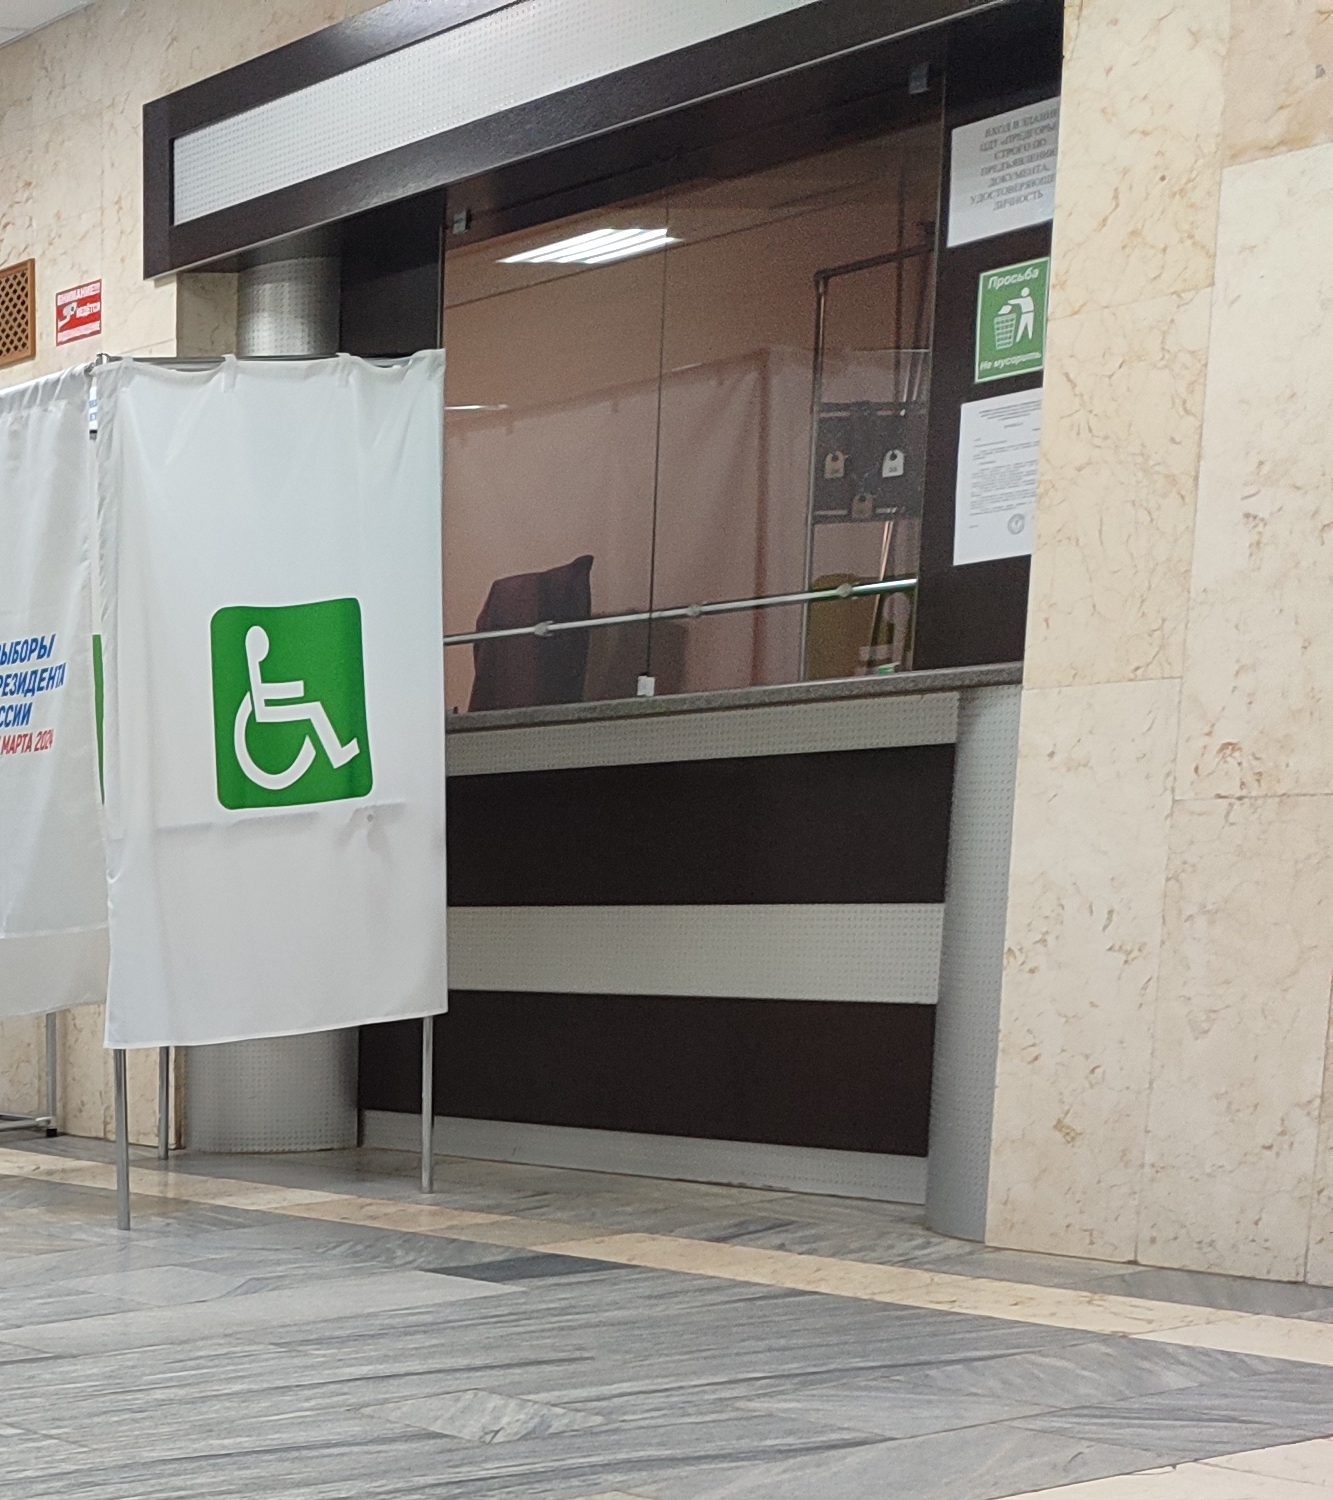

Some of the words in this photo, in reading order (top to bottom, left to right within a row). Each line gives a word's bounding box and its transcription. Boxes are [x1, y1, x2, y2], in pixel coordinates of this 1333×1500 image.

[994, 141, 1031, 161] СТРОГО
[1033, 138, 1047, 149] ПО
[993, 189, 1044, 211] ЛИЧНОСТЬ
[988, 267, 1039, 290] Просьба
[0, 732, 33, 756] МАРТА
[33, 729, 54, 751] 2024
